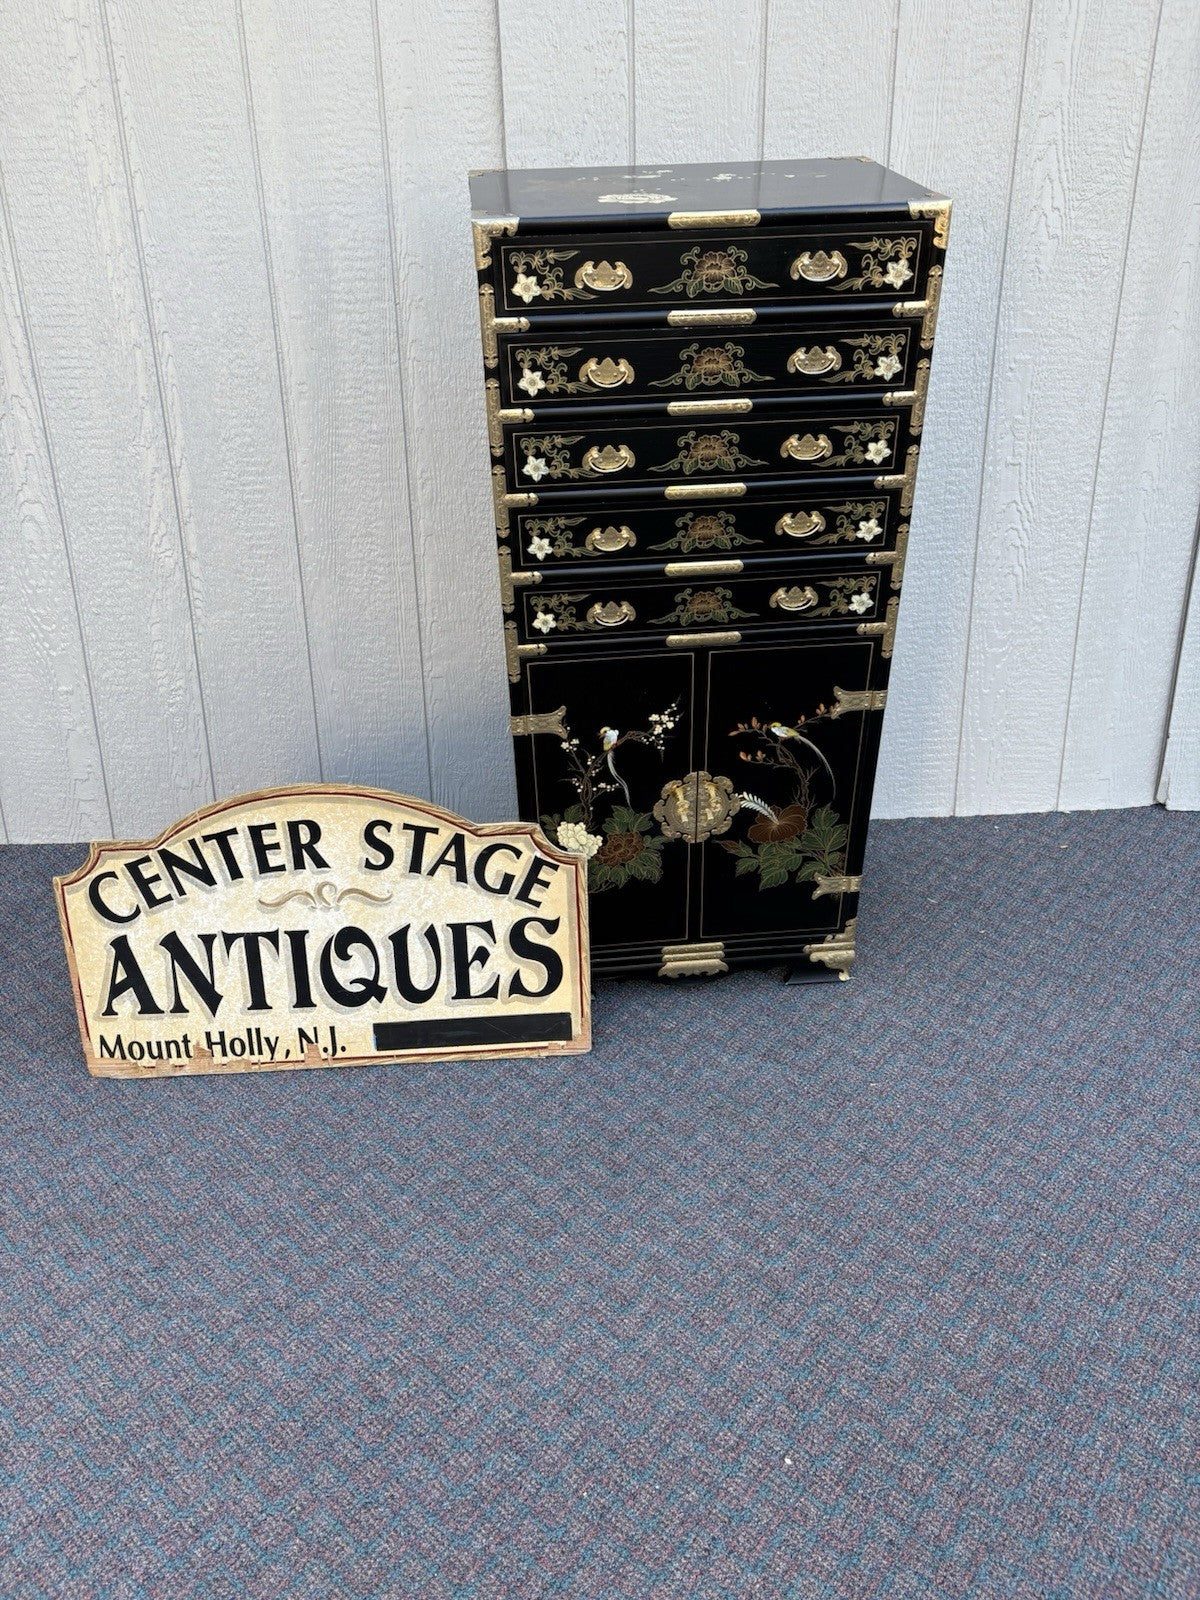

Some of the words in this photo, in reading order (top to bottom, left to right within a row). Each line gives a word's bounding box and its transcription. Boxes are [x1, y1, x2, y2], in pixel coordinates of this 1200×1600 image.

[88, 819, 331, 923] CENTER
[363, 819, 560, 908] STAGE
[101, 916, 564, 1017] ANTIQUES
[99, 1032, 193, 1061] Mount
[205, 1027, 291, 1060] Holly,
[298, 1025, 347, 1057] N.J.
